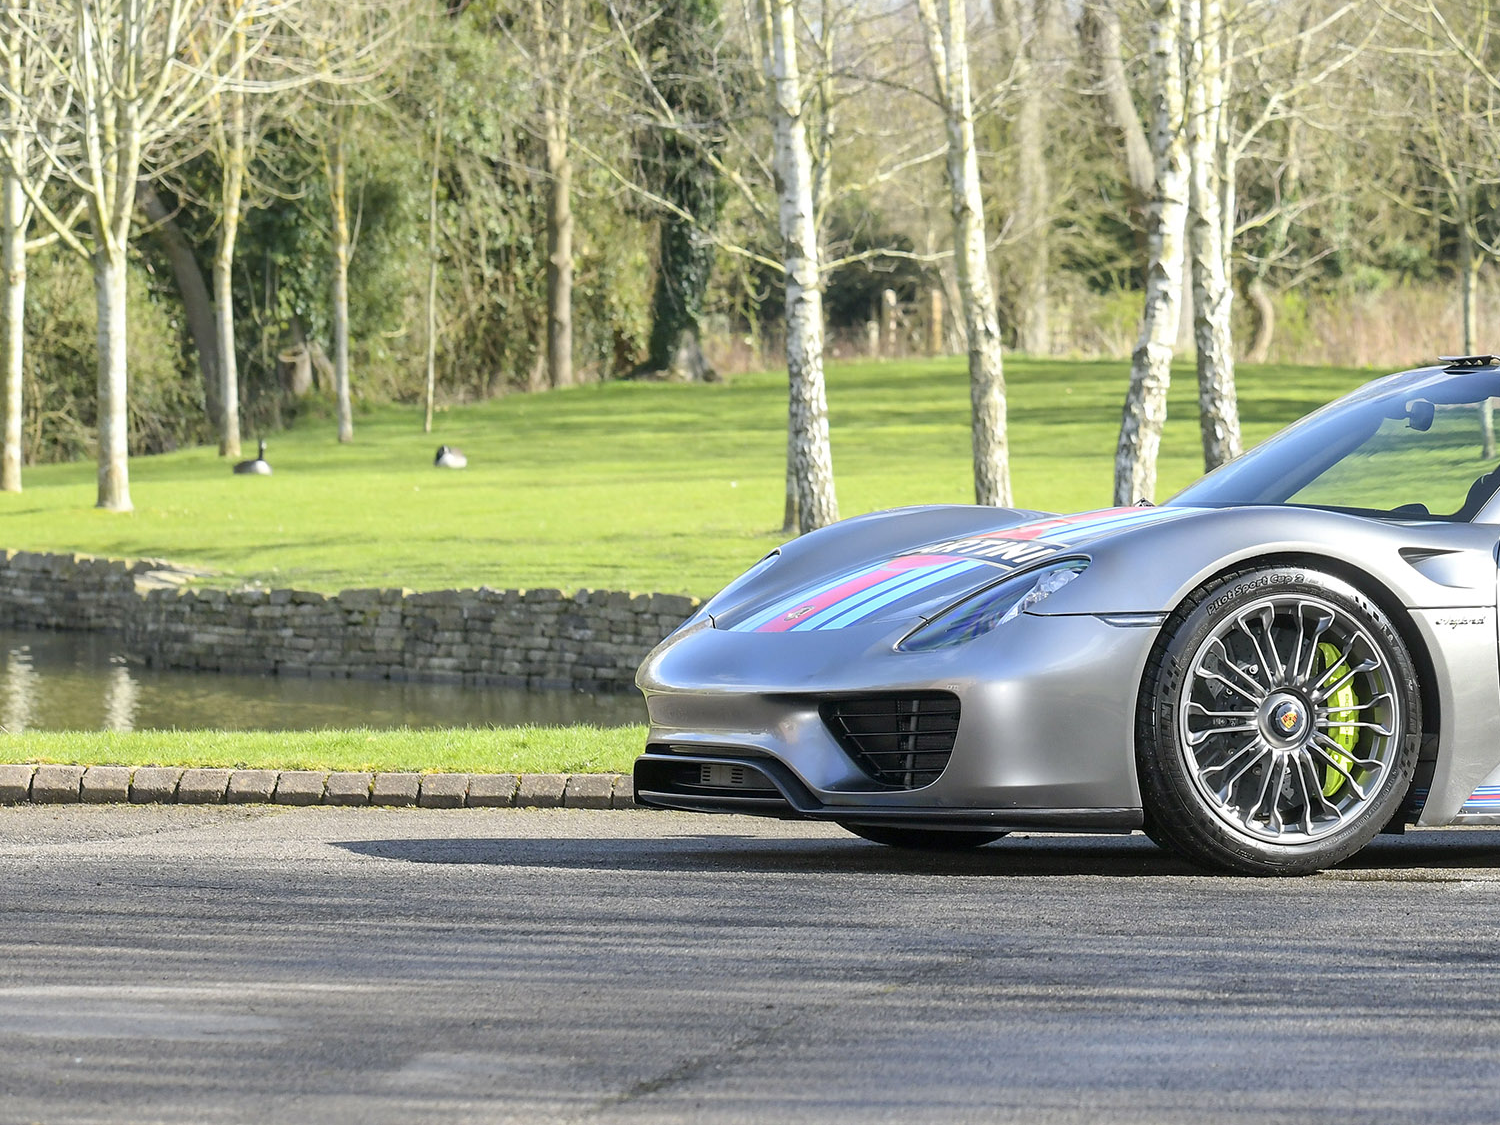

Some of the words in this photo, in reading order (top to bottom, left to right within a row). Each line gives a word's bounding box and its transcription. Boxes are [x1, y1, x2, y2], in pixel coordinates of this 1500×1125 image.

[902, 538, 1058, 564] ARTINI
[1206, 590, 1234, 615] Pilot
[1234, 576, 1269, 596] Sport
[1269, 573, 1293, 584] Cup
[1294, 573, 1305, 584] 2
